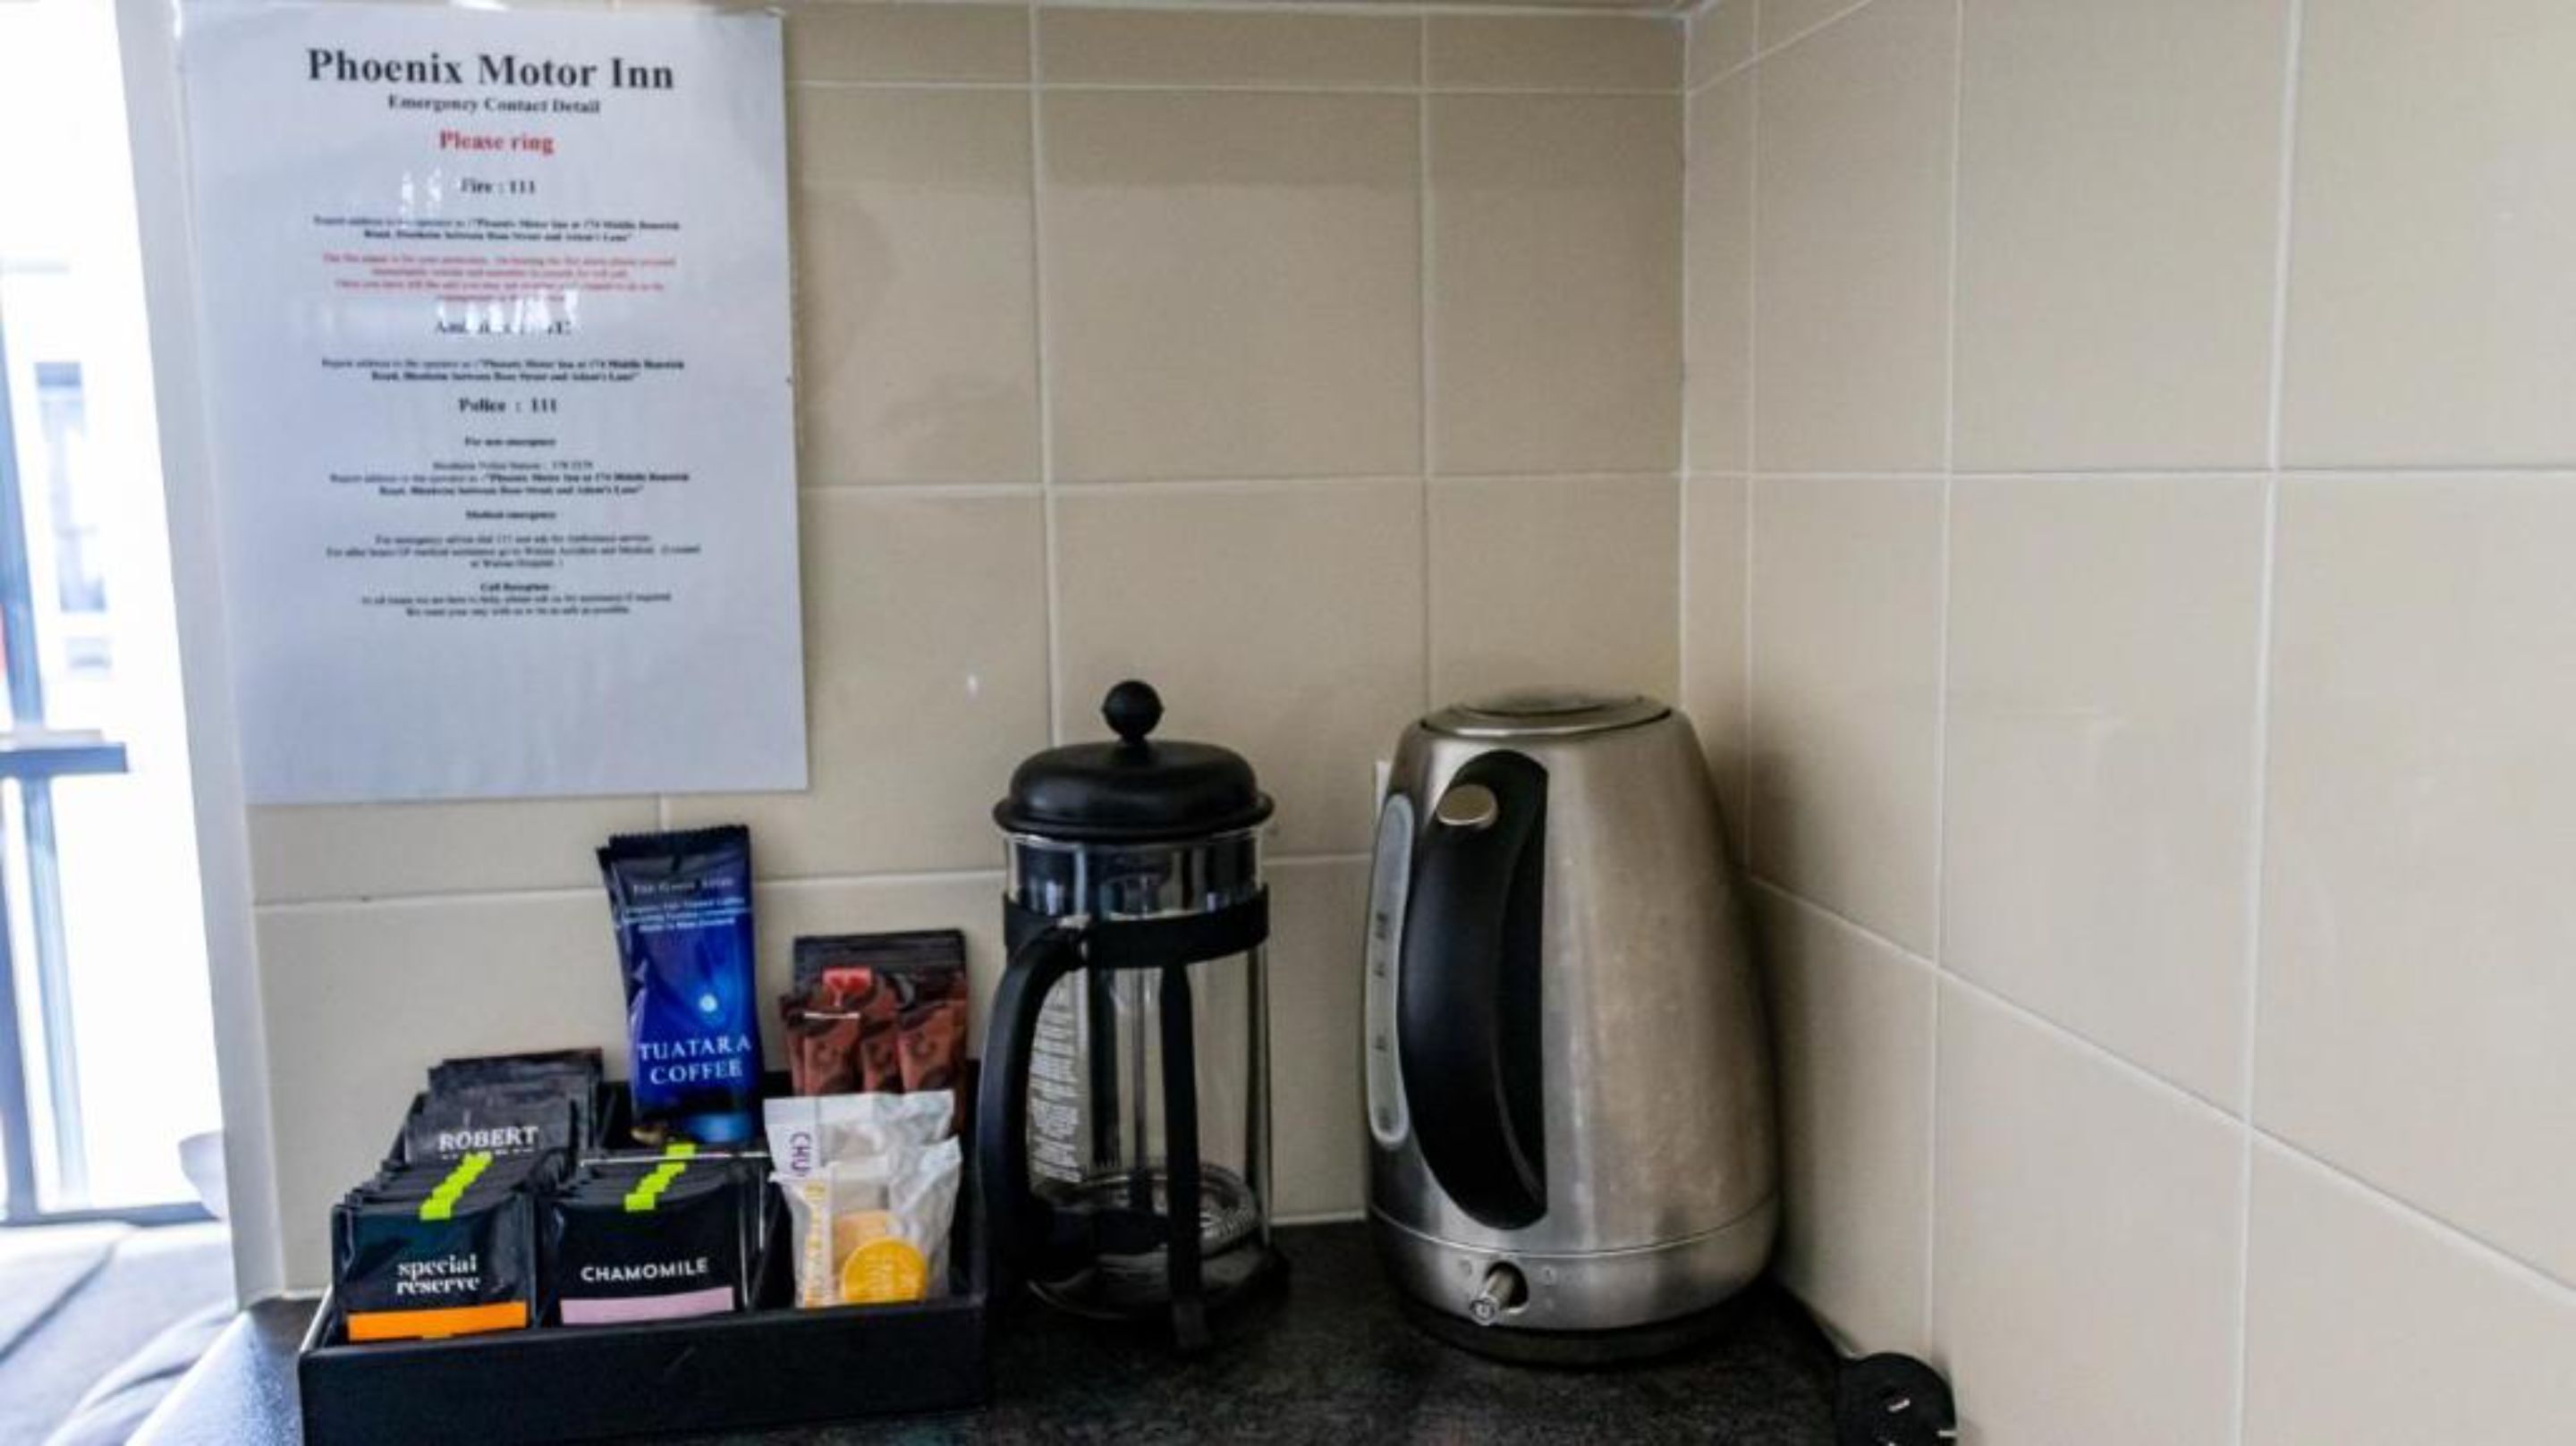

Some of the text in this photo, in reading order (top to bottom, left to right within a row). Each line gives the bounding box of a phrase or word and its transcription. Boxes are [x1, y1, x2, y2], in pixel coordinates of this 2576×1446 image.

[309, 49, 674, 89] Phoenix Motor Inn
[388, 93, 600, 114] Emergency Contact Detail
[440, 130, 555, 156] Please ring
[510, 179, 536, 195] 111
[459, 397, 506, 414] Police
[530, 396, 557, 414] 111
[638, 1034, 751, 1061] TUATARA
[650, 1058, 743, 1085] COFFEE
[438, 1125, 539, 1153] ROBERT
[790, 1131, 811, 1178] CHU
[396, 1254, 478, 1281] special
[581, 1256, 708, 1283] CHAMOMILE
[396, 1276, 480, 1296] reserve
